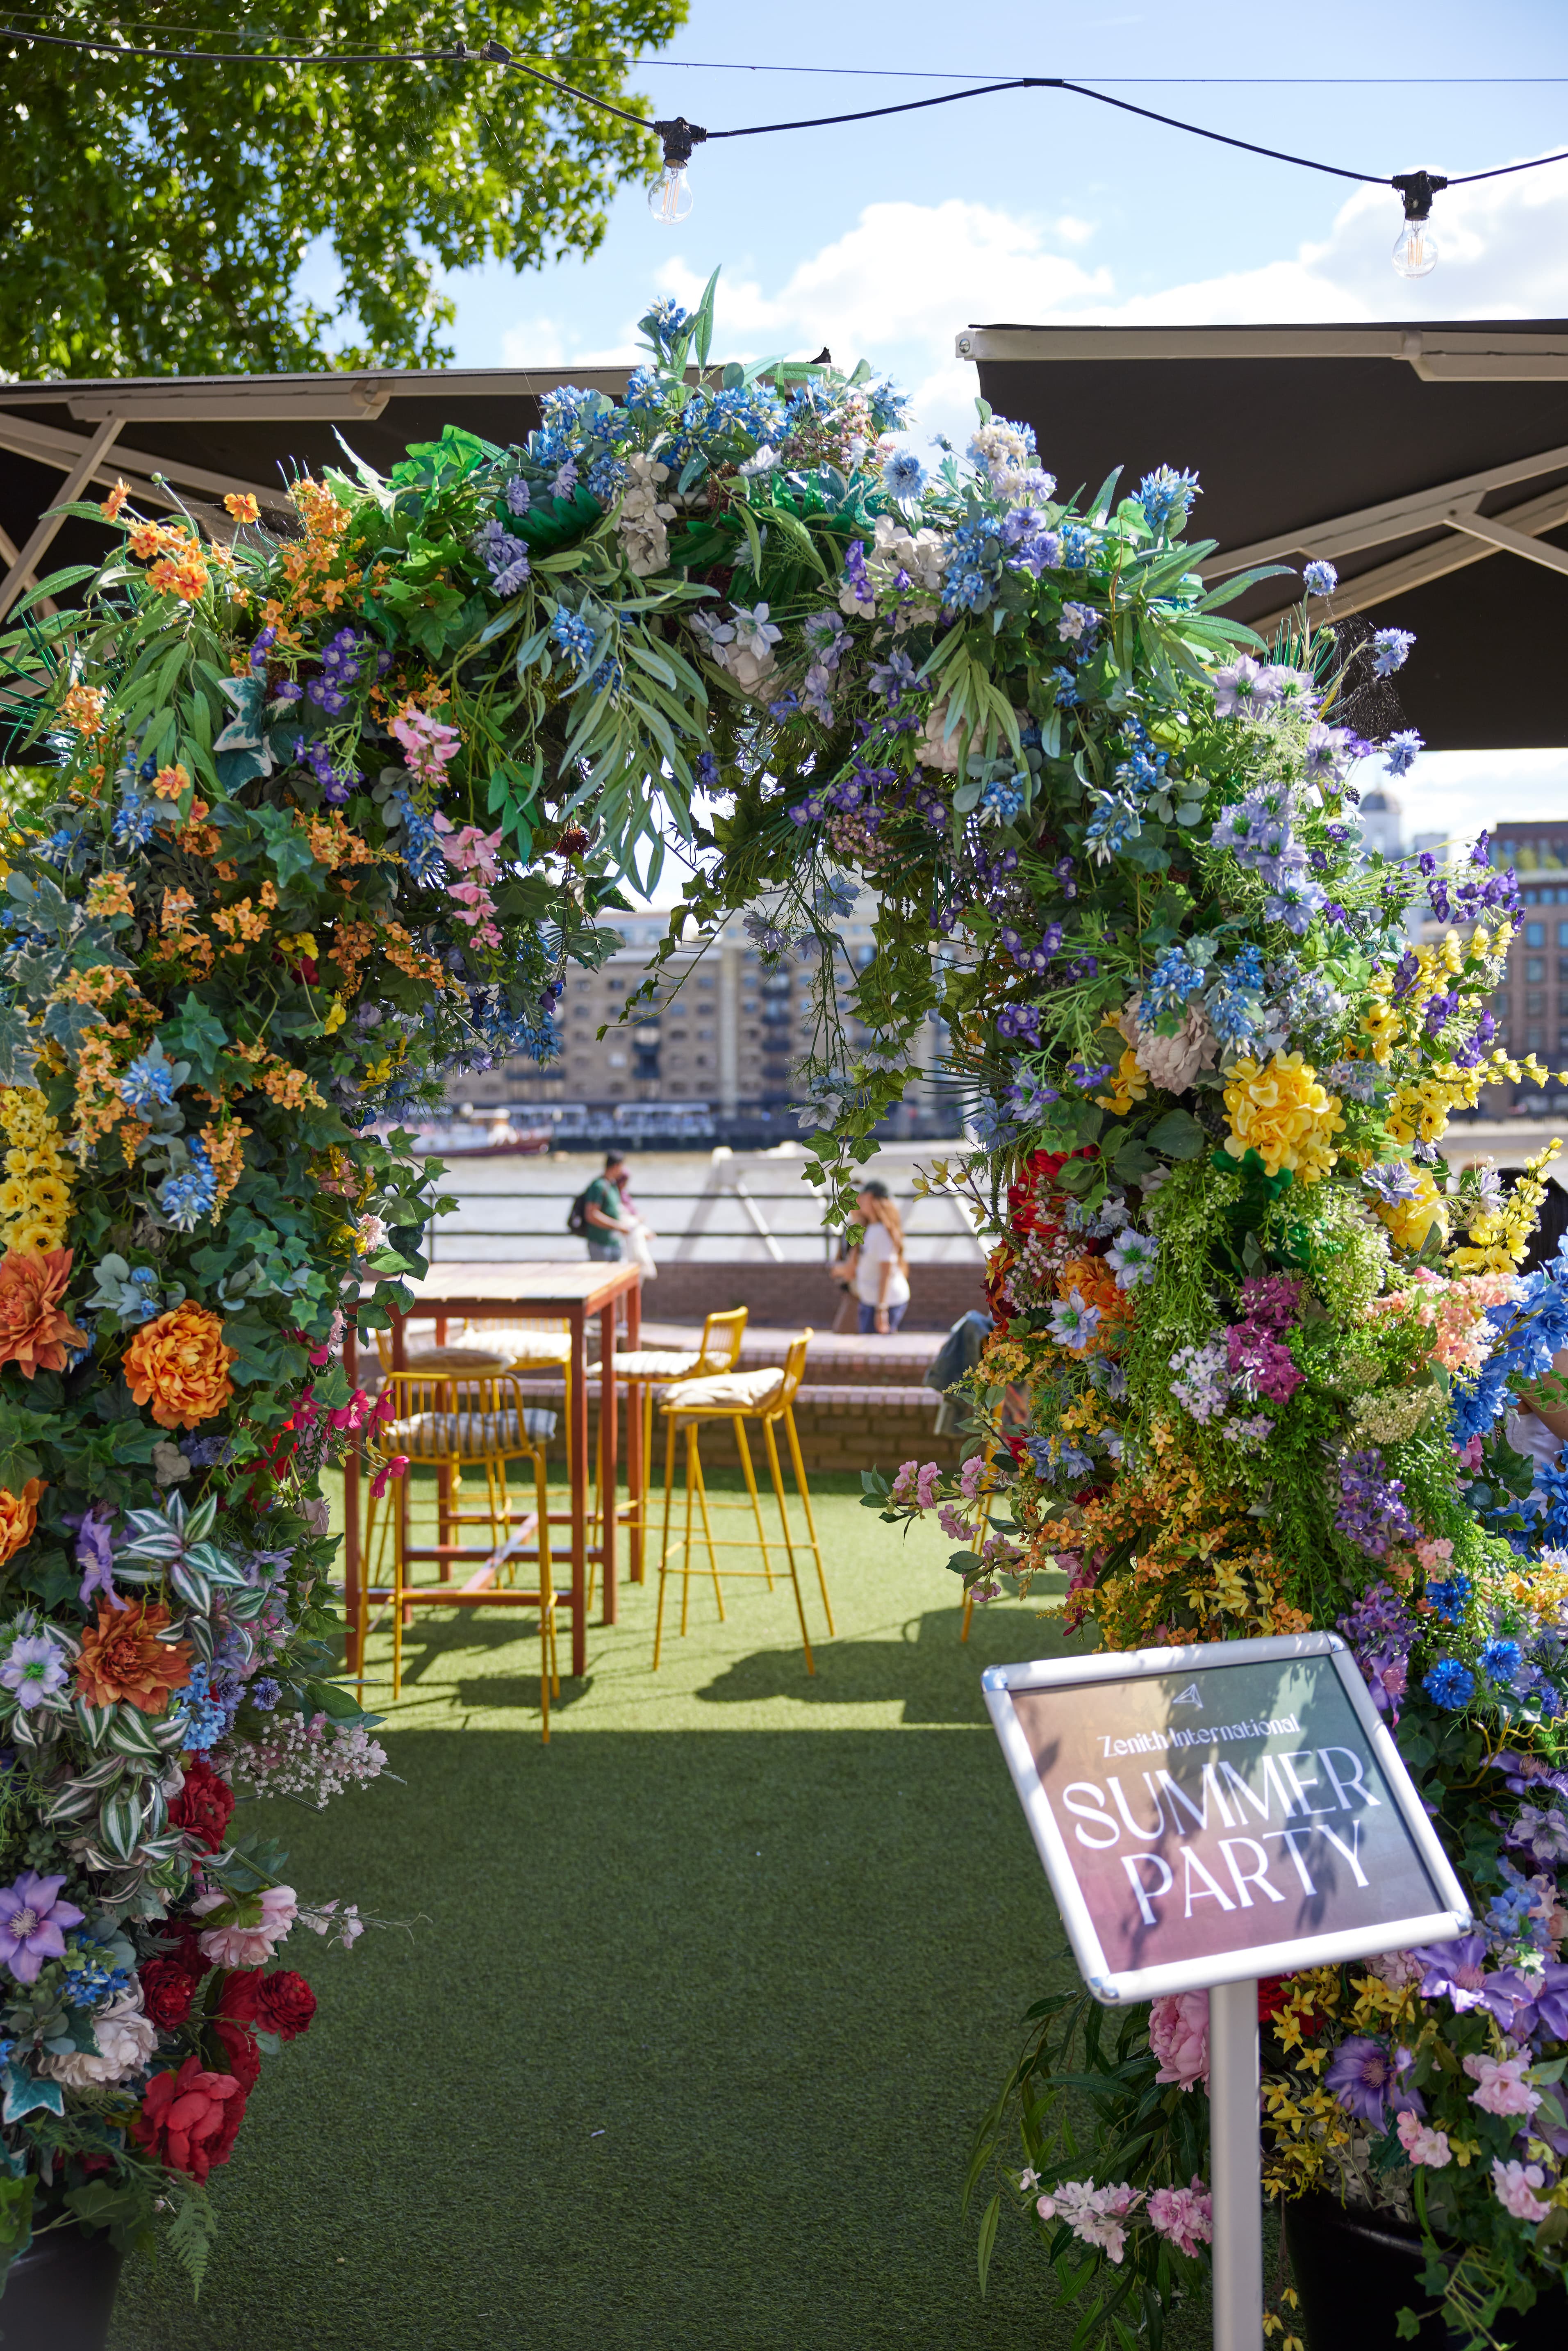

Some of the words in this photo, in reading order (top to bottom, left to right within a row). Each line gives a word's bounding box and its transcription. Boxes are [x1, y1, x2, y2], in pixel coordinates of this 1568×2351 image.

[1097, 1730, 1169, 1758] Zenith
[1168, 1713, 1301, 1747] International
[1063, 1746, 1381, 1849] SUMMER
[1120, 1819, 1370, 1924] PARTY
